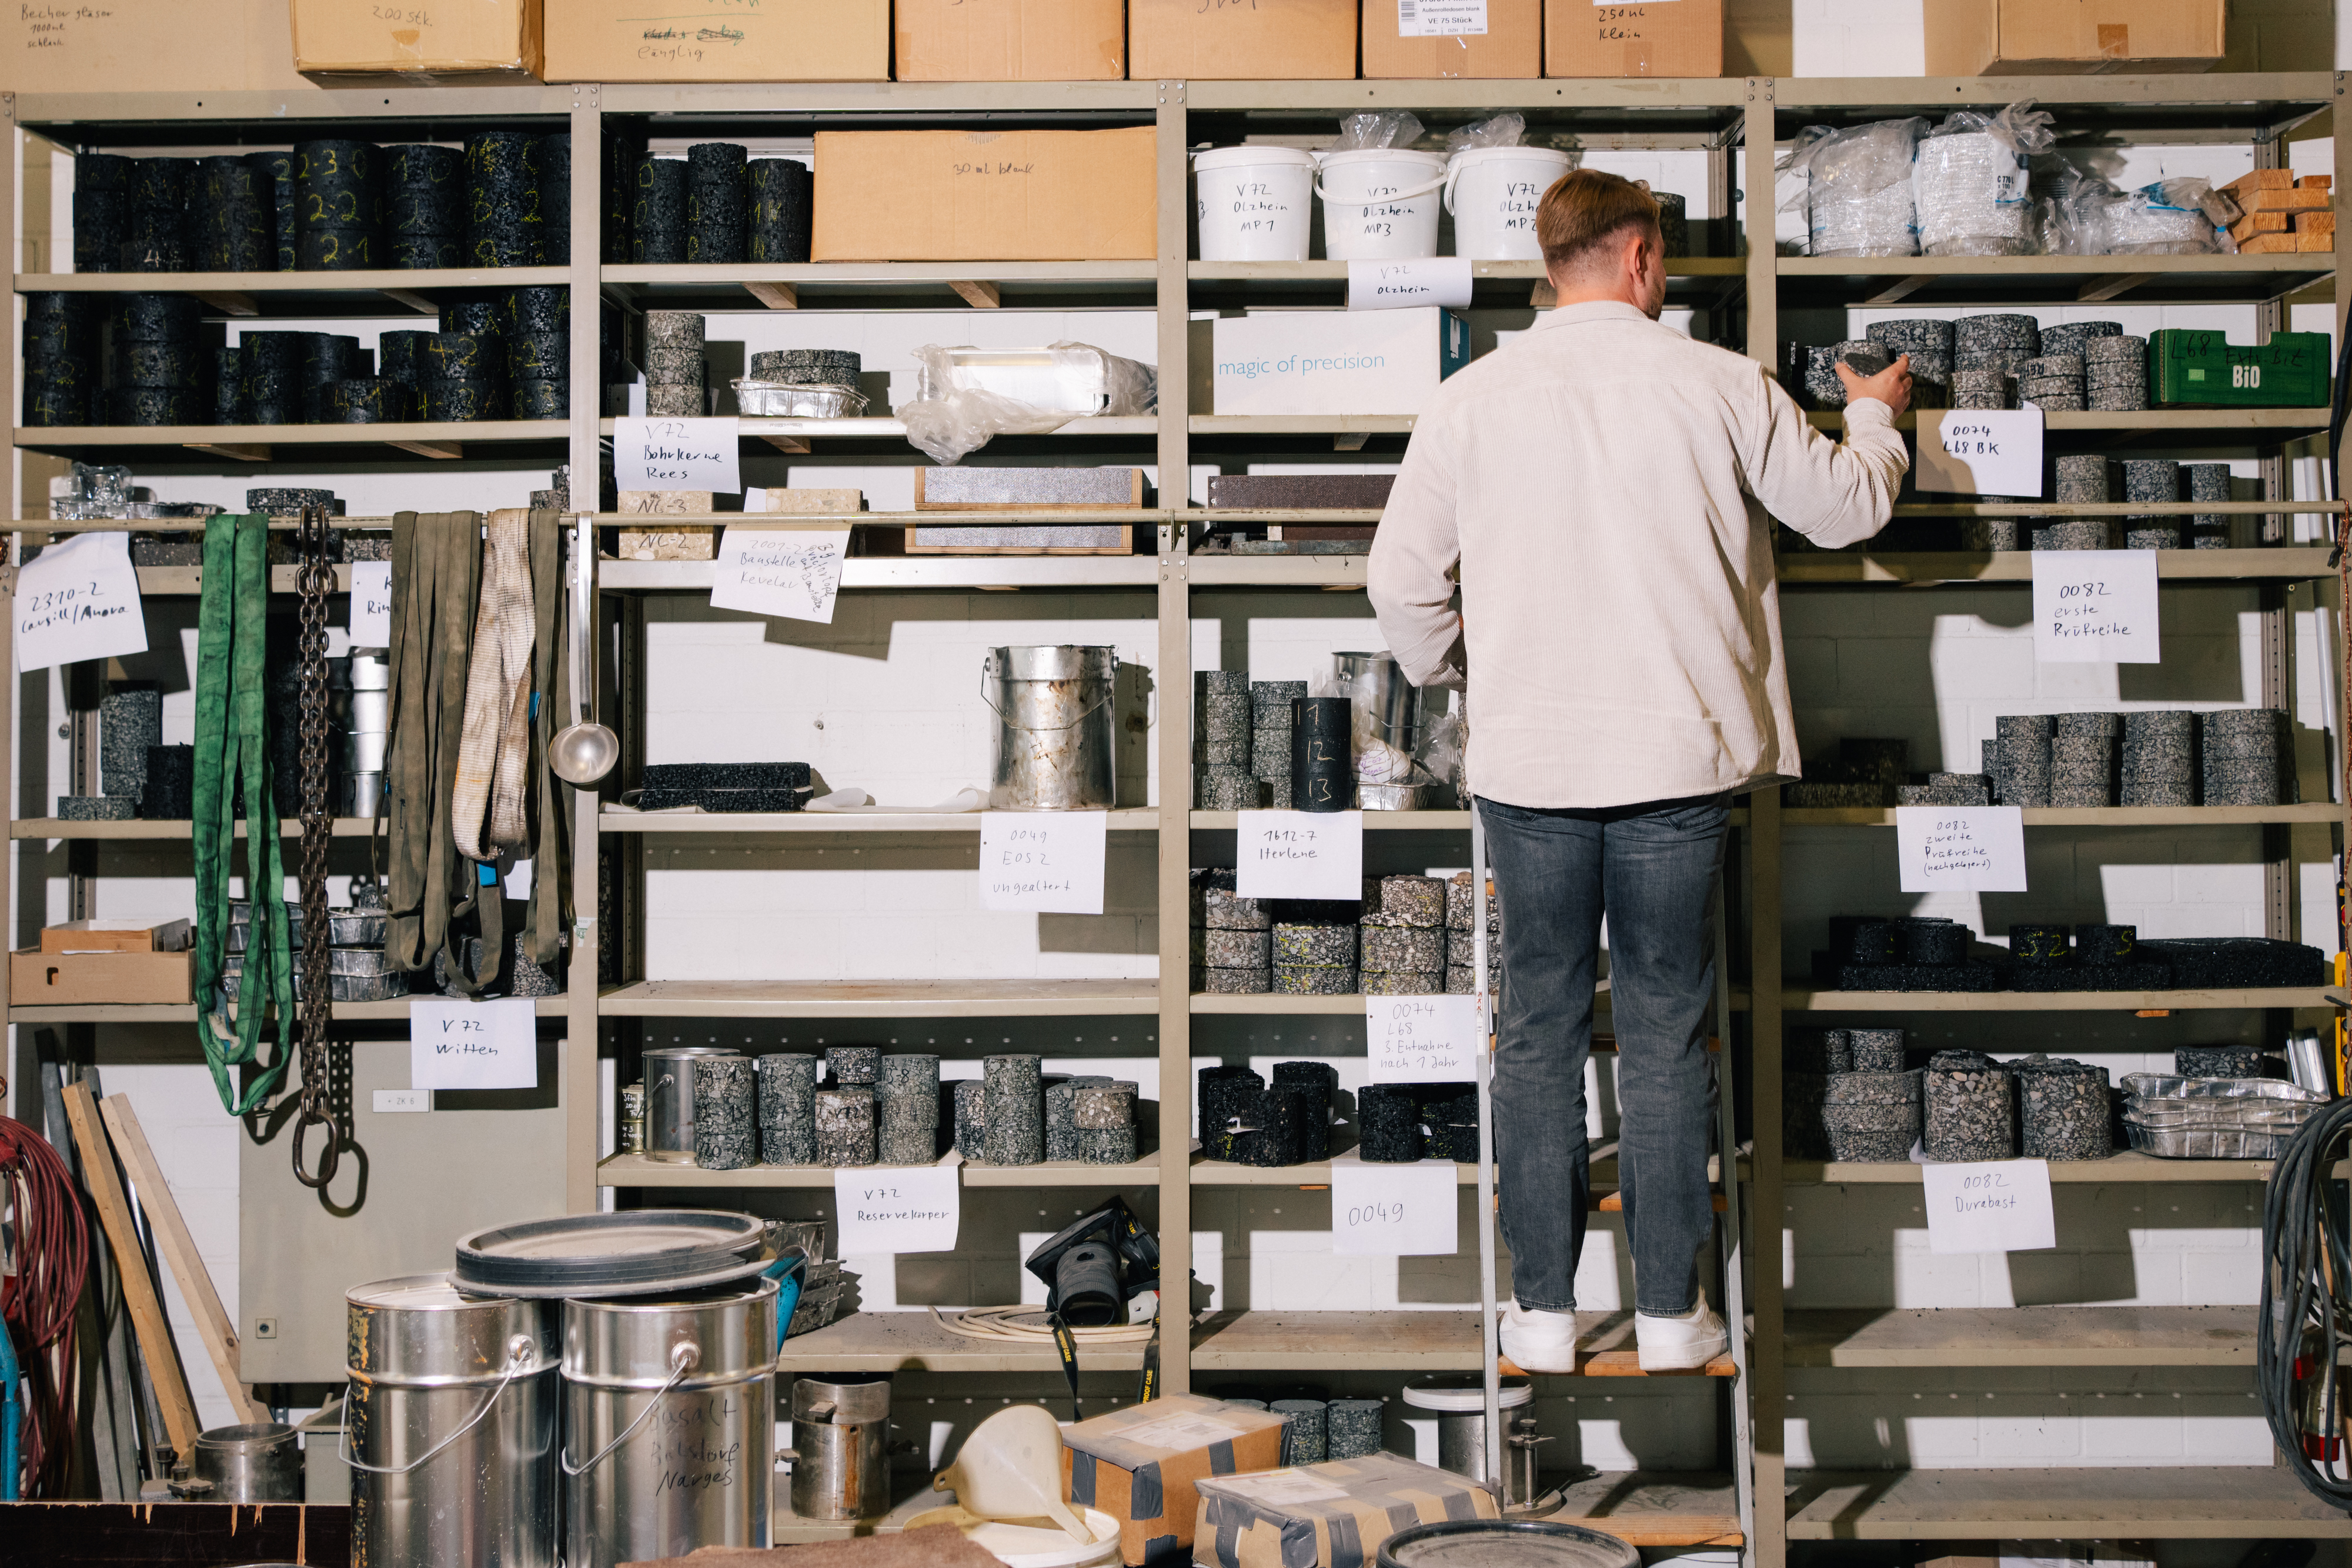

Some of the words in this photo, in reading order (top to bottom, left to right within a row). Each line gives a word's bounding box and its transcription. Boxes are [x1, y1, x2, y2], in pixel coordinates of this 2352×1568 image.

[373, 6, 401, 20] 200
[1599, 9, 1624, 22] 250
[1599, 27, 1641, 41] Klein
[953, 163, 971, 175] 30
[2171, 333, 2211, 360] L68
[1219, 357, 1269, 379] magic
[1277, 355, 1298, 372] of
[1302, 352, 1385, 376] precision
[1953, 426, 1992, 438] 0074
[646, 466, 689, 480] Rees
[2060, 582, 2112, 599] 0082
[2054, 604, 2099, 618] erste
[1937, 821, 1970, 831] 0082
[1011, 830, 1047, 844] 0049
[1263, 831, 1318, 842] 1612-7
[1926, 833, 1973, 844] zweite
[1040, 853, 1051, 865] 2
[993, 880, 1071, 895] ungealtert
[1392, 1002, 1436, 1019] 0074
[1388, 1022, 1412, 1036] L68
[436, 1043, 498, 1056] Witten
[1398, 1039, 1454, 1054] Entnahme
[1381, 1058, 1409, 1068] nach
[1964, 1174, 2010, 1189] 0082
[1955, 1194, 2017, 1213] Durabast
[857, 1209, 950, 1222] Reservekörper
[1348, 1202, 1403, 1226] 0049
[1063, 1349, 1072, 1362] CASE
